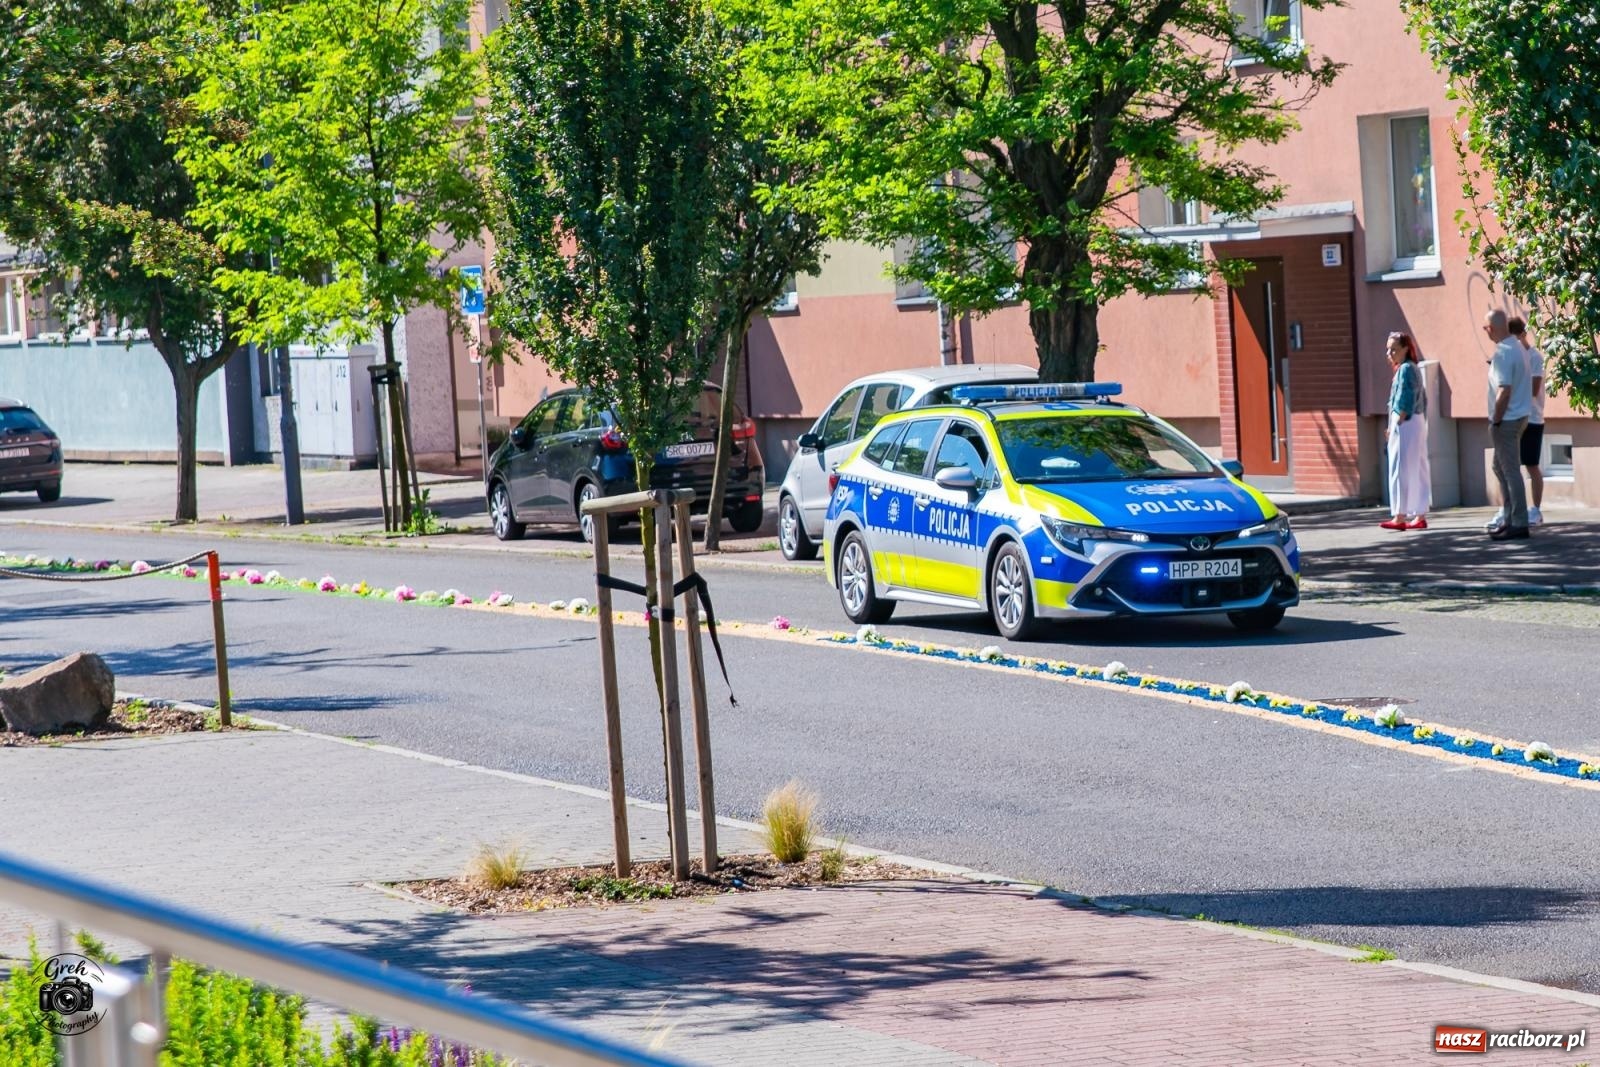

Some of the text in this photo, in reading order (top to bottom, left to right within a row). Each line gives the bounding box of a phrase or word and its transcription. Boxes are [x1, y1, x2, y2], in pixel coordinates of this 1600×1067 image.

[1014, 386, 1058, 398] POLICJA
[1125, 499, 1234, 516] POLICJA
[929, 507, 970, 540] POLICJA
[1172, 560, 1239, 578] HPP R204
